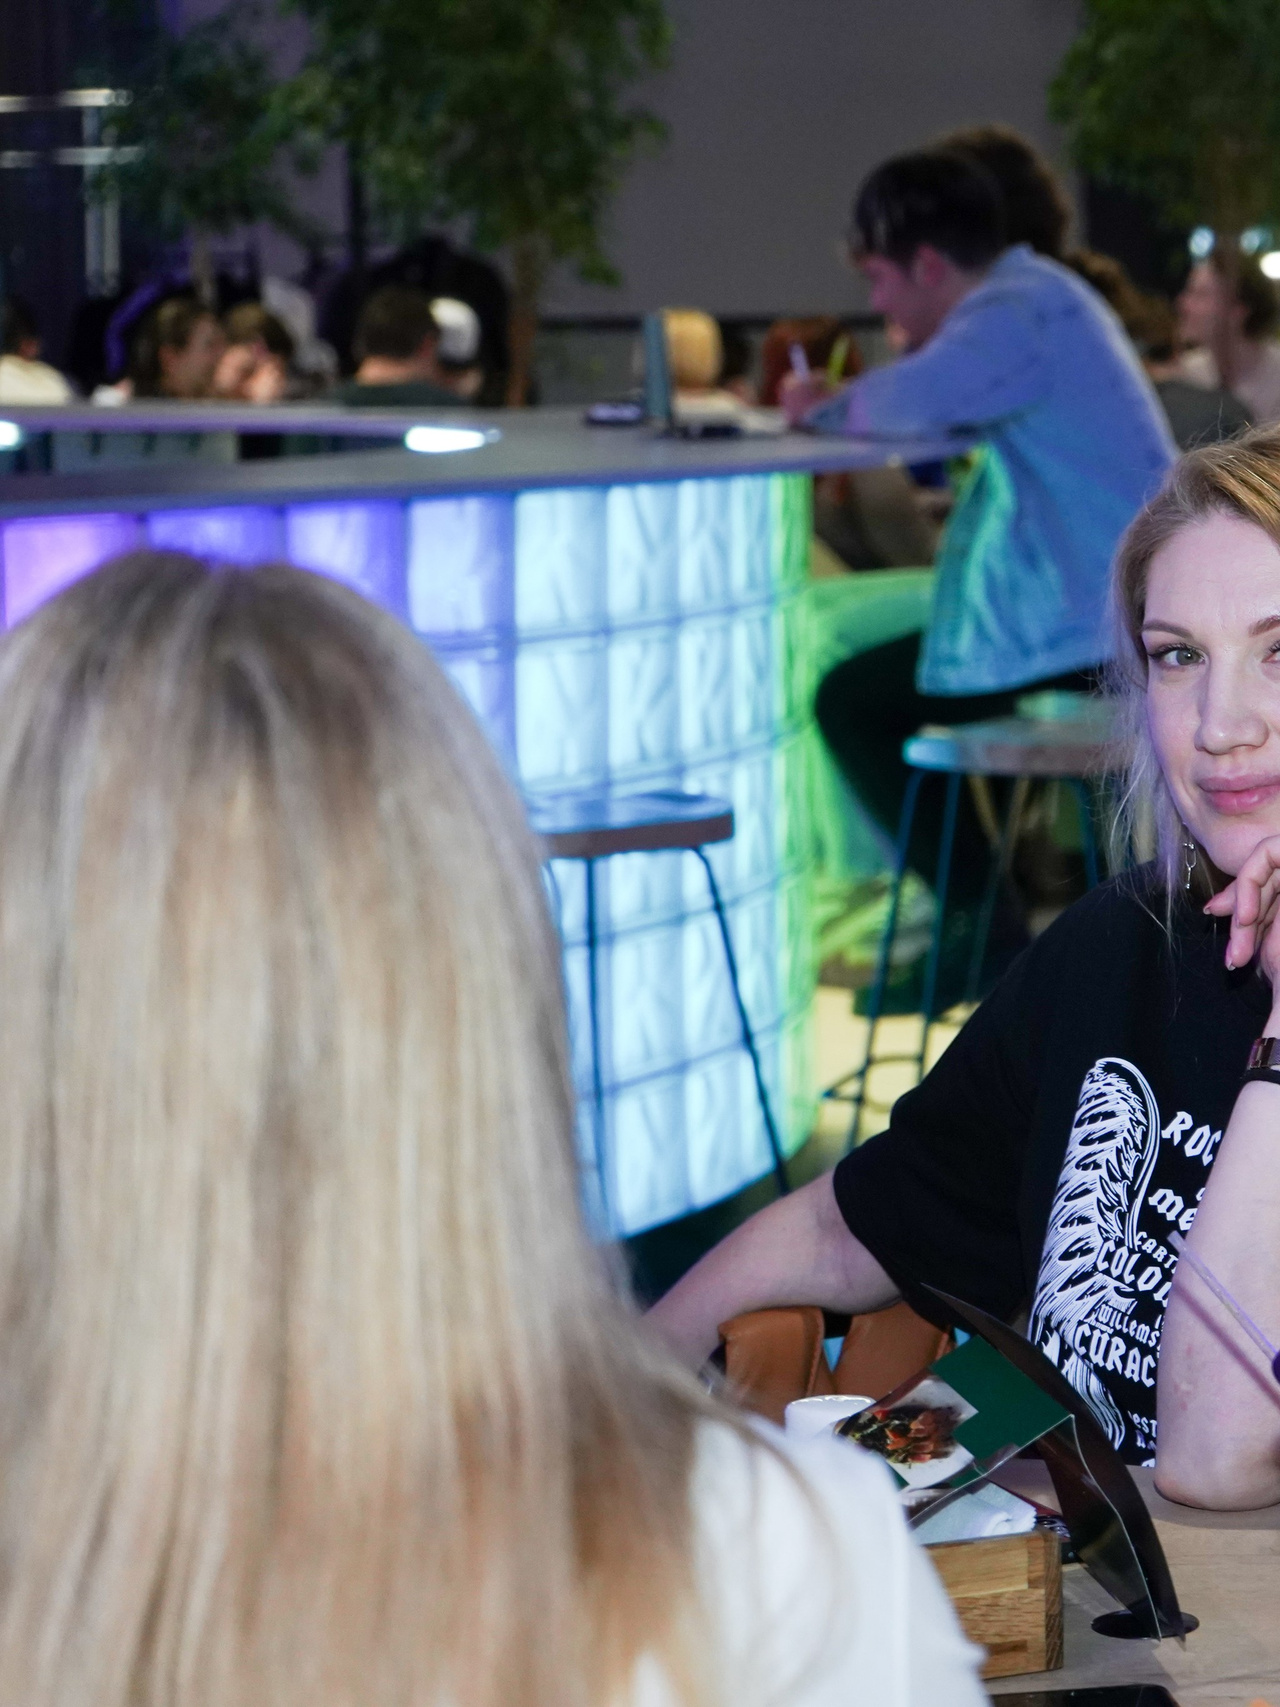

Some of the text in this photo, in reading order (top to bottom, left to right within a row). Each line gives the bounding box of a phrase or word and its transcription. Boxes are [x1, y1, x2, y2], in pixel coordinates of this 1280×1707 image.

[1161, 1111, 1222, 1167] ROC
[1098, 1303, 1160, 1348] Willems
[1074, 1323, 1156, 1388] CURAC
